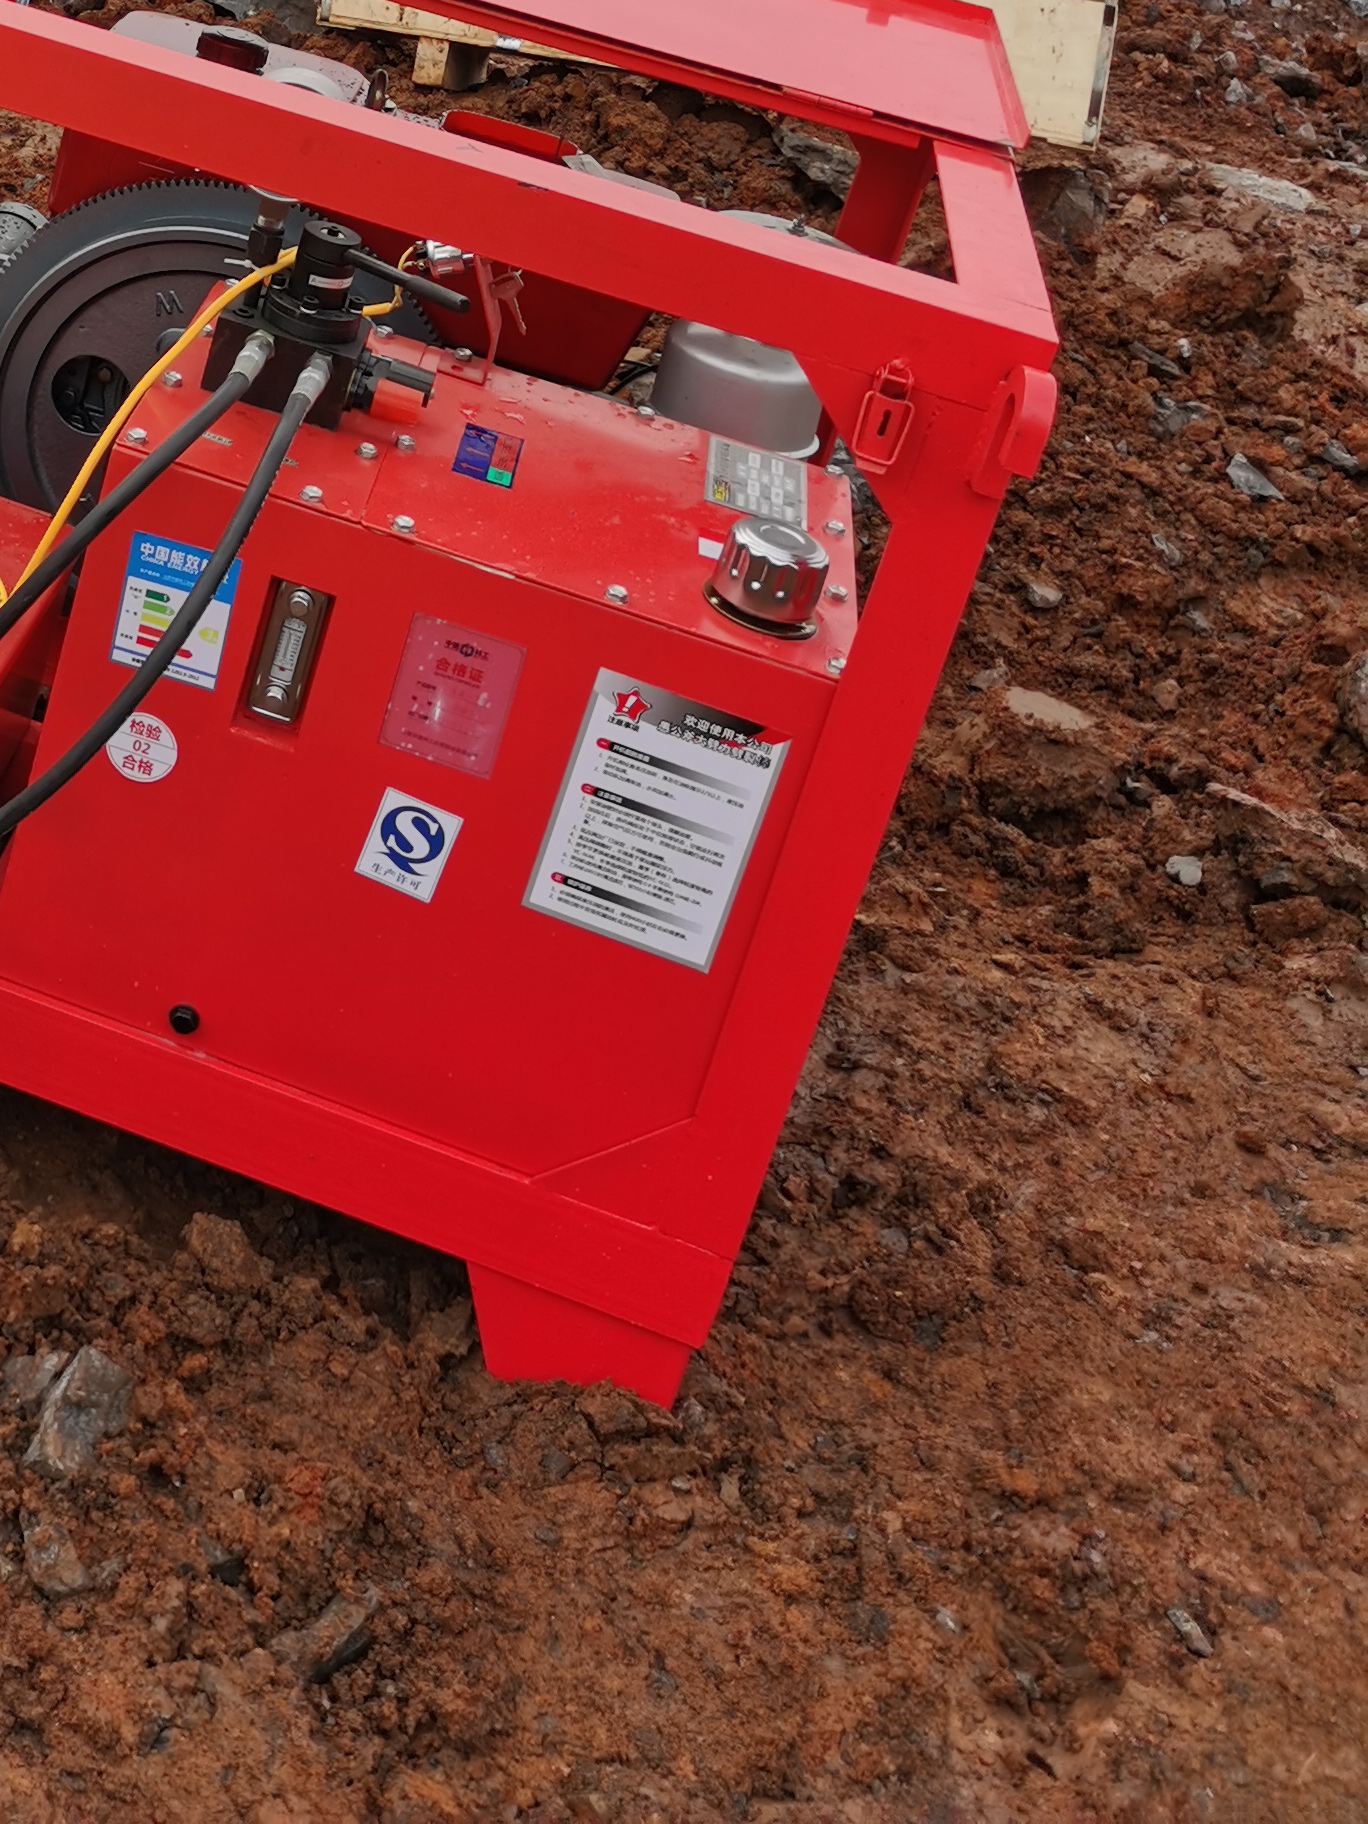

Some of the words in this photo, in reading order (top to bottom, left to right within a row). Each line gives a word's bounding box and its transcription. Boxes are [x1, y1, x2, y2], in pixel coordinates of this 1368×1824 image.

[435, 658, 484, 683] 合格证
[130, 718, 162, 742] 检验
[682, 714, 773, 755] 欢迎使用本公司
[133, 739, 151, 755] 02
[122, 754, 154, 776] 合格
[371, 863, 422, 890] 生产许可
